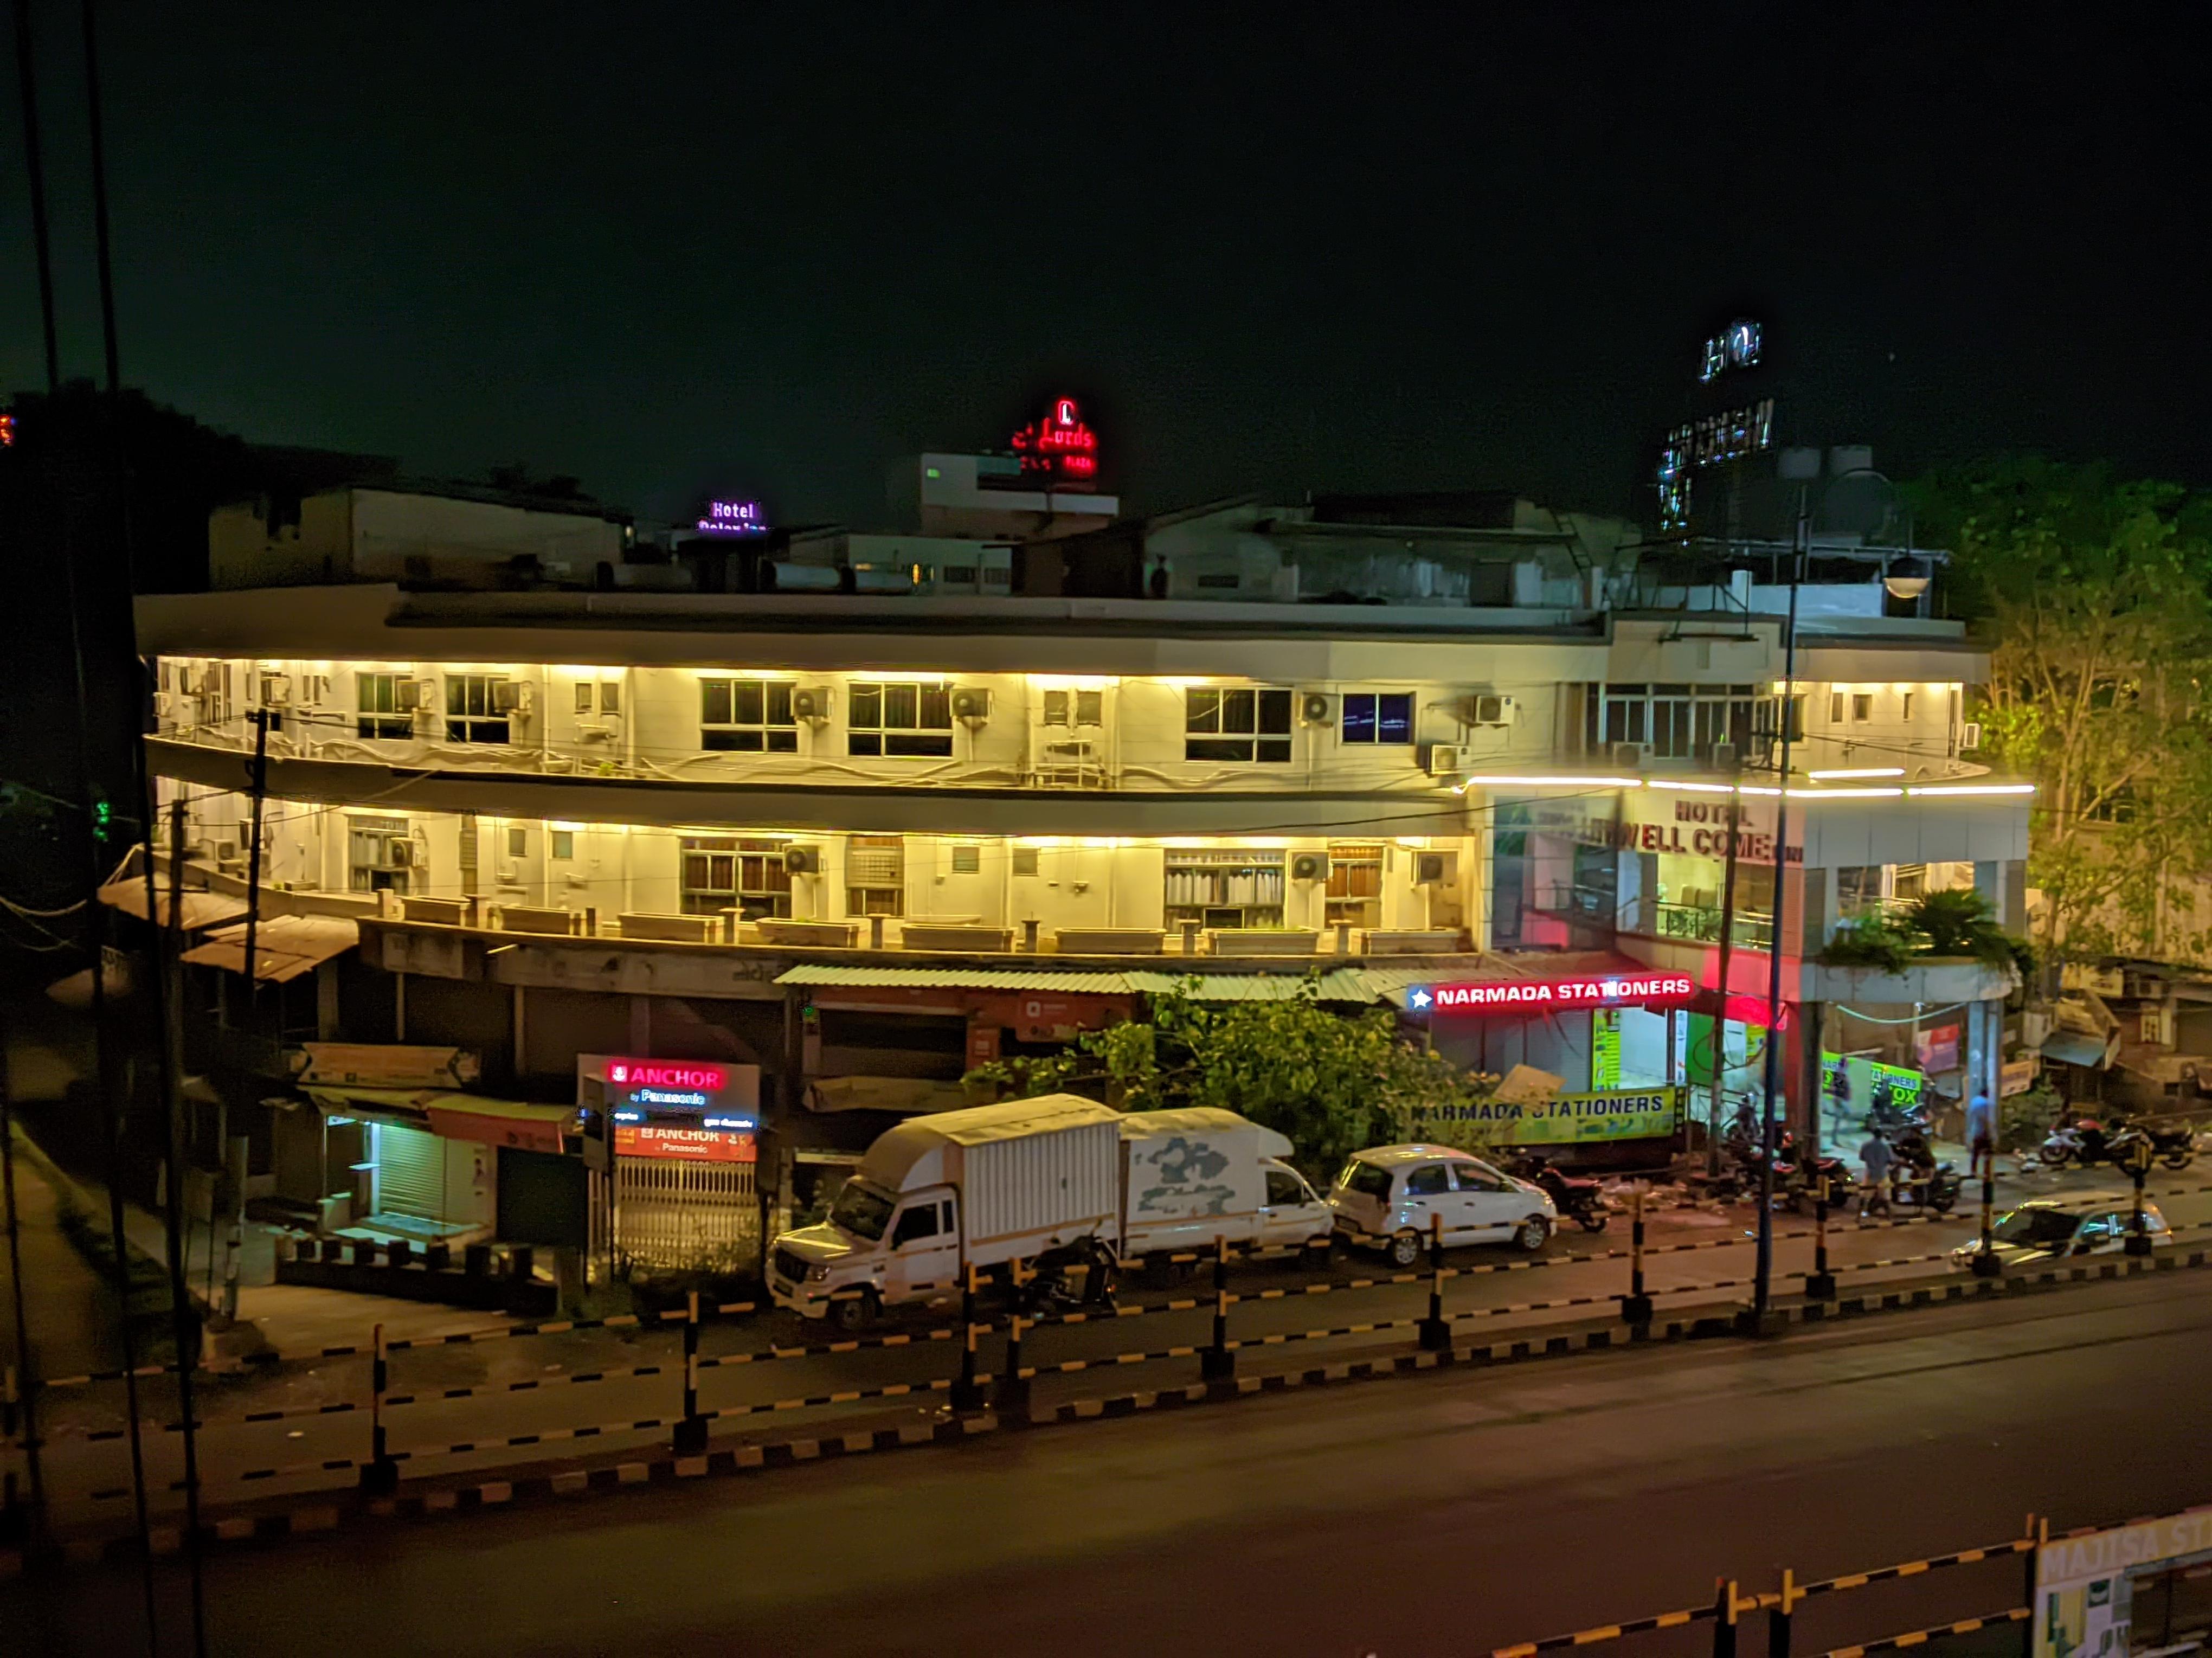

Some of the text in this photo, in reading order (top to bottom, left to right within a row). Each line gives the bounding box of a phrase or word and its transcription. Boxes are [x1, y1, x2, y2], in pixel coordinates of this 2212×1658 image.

[713, 502, 754, 518] Hotel
[1675, 800, 1754, 826] HOTL
[1437, 979, 1690, 1006] NARMADA STATIONERS
[631, 1067, 719, 1087] ANCHOR
[641, 1089, 705, 1105] Panasonic
[655, 1128, 720, 1142] ANCHOR
[662, 1142, 708, 1154] Panasonic
